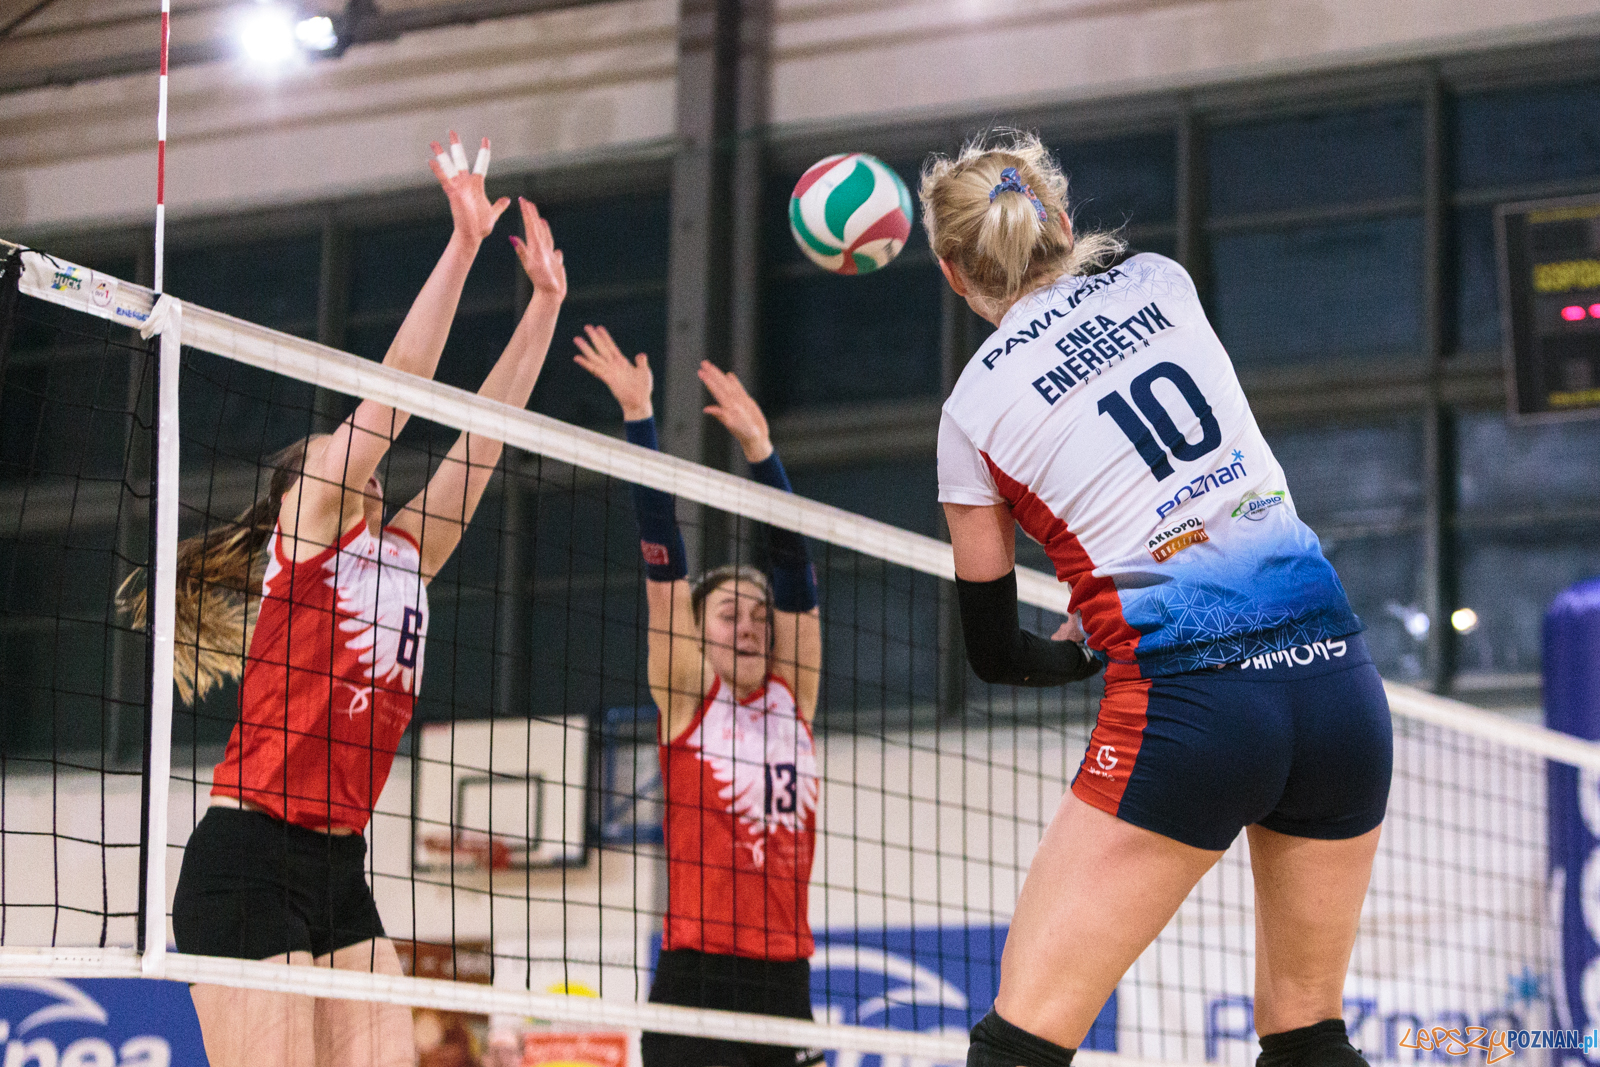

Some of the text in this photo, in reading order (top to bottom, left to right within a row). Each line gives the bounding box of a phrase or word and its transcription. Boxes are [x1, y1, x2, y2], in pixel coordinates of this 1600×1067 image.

[53, 274, 82, 290] HUCK
[1032, 302, 1175, 406] ENERGETYK
[1055, 315, 1117, 357] ENEA
[1097, 361, 1222, 483] 10
[1148, 517, 1203, 548] AKROPOL
[396, 605, 423, 669] 6
[764, 762, 797, 814] 13
